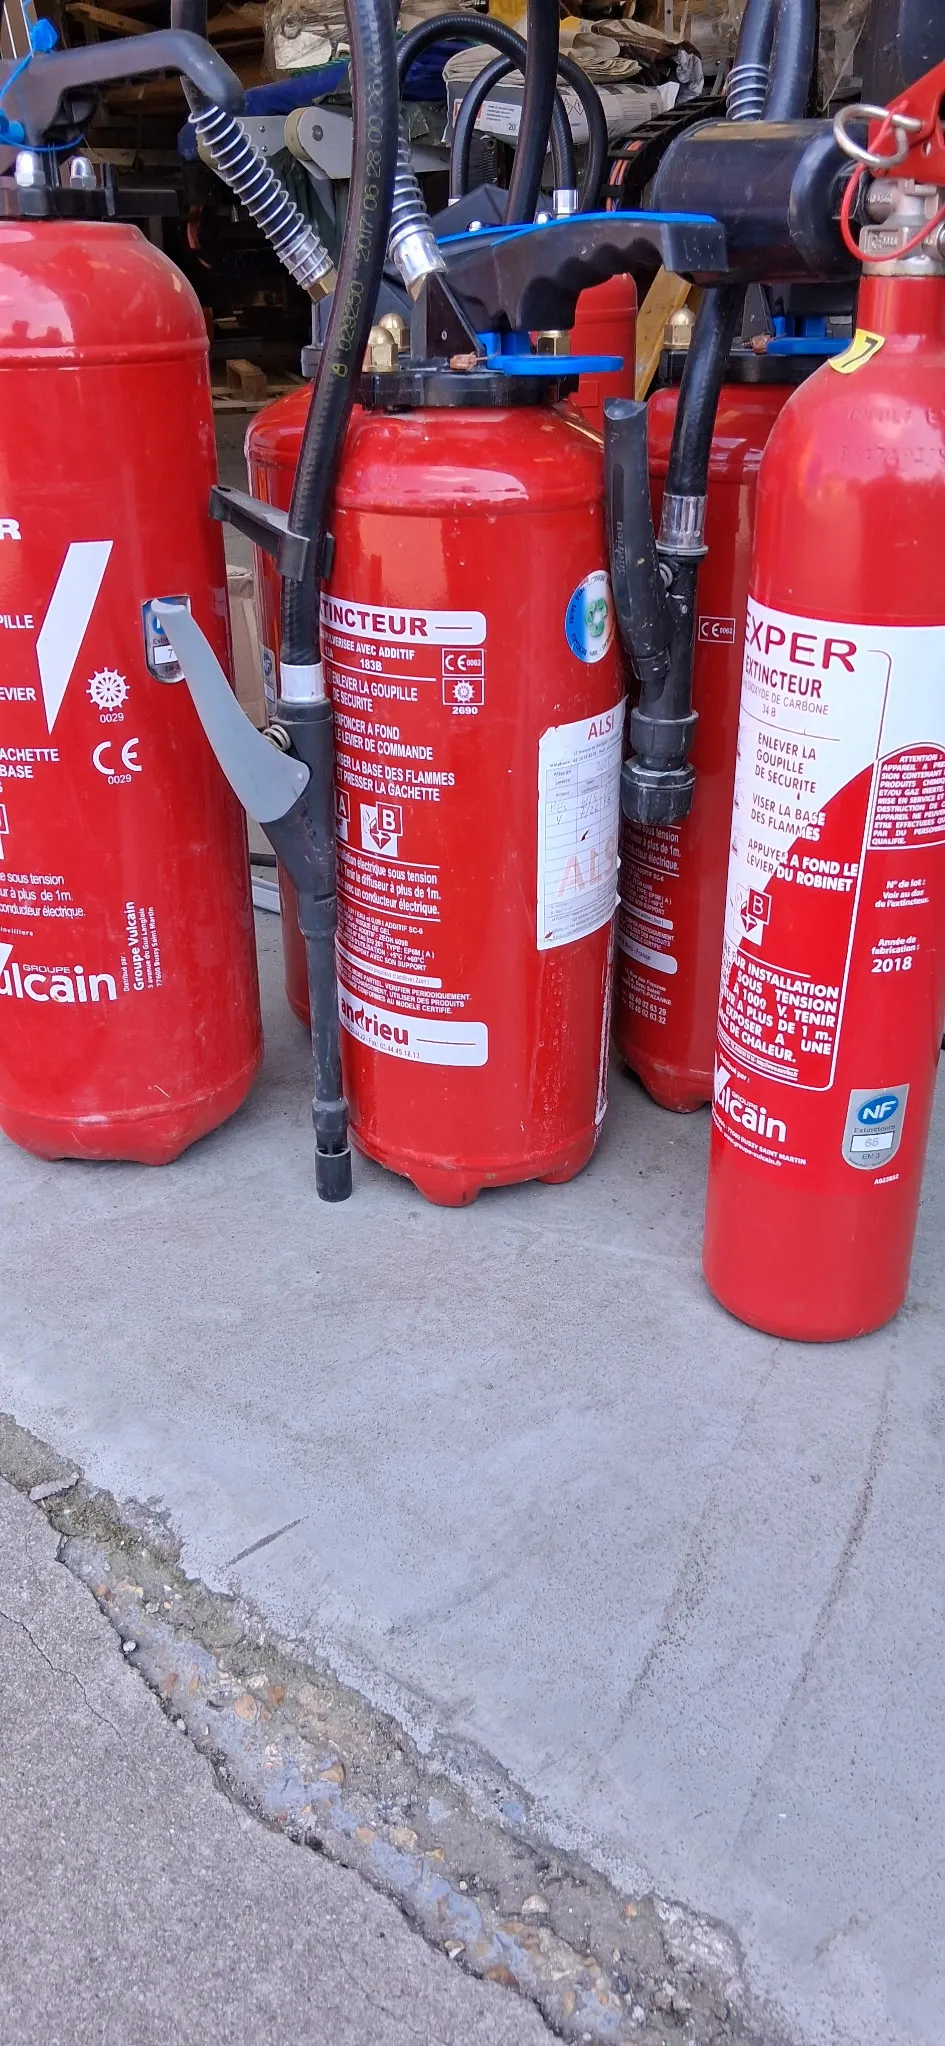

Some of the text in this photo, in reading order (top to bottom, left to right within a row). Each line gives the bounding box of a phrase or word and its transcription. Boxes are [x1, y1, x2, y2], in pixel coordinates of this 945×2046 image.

[366, 150, 382, 178] 28
[363, 184, 380, 212] 06
[355, 215, 374, 262] 2017
[338, 281, 364, 351] 029250
[320, 600, 428, 637] TINCTEUR
[356, 642, 416, 660] AVEC ADDITIF
[359, 658, 383, 672] 183B
[445, 654, 467, 671] CE
[332, 671, 418, 702] ENLEVER LA GOUPILLE
[745, 654, 822, 699] EXTINCTEUR
[340, 690, 374, 712] SECURITE
[451, 706, 479, 715] 2690
[771, 692, 781, 704] DE
[783, 696, 829, 716] CARBONE
[99, 713, 124, 724] 0029
[334, 711, 400, 740] ENFONCER A FOND
[587, 713, 615, 740] ALSI
[342, 731, 434, 760] LEVIER DE COMMANDE
[758, 732, 816, 760] ENLEVER LA
[92, 737, 143, 775] CE
[756, 749, 804, 775] GOUPILLE
[899, 754, 938, 763] ATTENTION
[0, 765, 34, 779] BASE
[107, 774, 132, 785] 0029
[351, 758, 456, 786] LA BASE DES FLAMMES
[755, 764, 817, 794] DE SECURITE
[881, 769, 942, 780] SION CONTENANT
[343, 770, 441, 802] PRESSER LA GACHETTE
[879, 788, 920, 797] ET/OU GAZ
[880, 780, 916, 788] PRODUITS
[339, 794, 347, 816] A
[752, 792, 827, 827] VISER LA BASE
[877, 802, 938, 813] DESTRUCTION DE
[878, 794, 935, 805] MISE EN SERVICE
[382, 808, 396, 831] B
[751, 808, 821, 842] DES FLAMMES
[874, 818, 935, 829] ETRE EFFECTUEES
[875, 812, 922, 821] APPAREIL NE
[656, 828, 679, 843] tension
[873, 829, 907, 837] PAR DU
[660, 842, 669, 854] de
[748, 838, 859, 877] APPUYER A FOND LE
[7, 872, 29, 884] sous
[30, 873, 64, 885] tension
[387, 864, 406, 880] sous
[407, 870, 438, 884] tension
[746, 852, 854, 892] LEVIER DU ROBINET
[361, 874, 424, 899] diffuseur plus de
[898, 879, 922, 888] de lot
[18, 889, 53, 902] plus de
[361, 889, 440, 915] conducteur électrique.
[874, 900, 886, 908] de
[882, 891, 899, 899] Voir
[911, 889, 924, 897] dos
[42, 905, 86, 919] électrique.
[752, 896, 764, 915] B
[138, 907, 148, 936] Langlois
[148, 906, 156, 929] Martin
[124, 901, 145, 991] Groupe Vulcain
[871, 944, 916, 955] fabrication
[878, 936, 917, 947] Année de
[23, 964, 71, 974] GROUPE
[397, 960, 427, 971] SUPPORT
[871, 956, 912, 973] 2018
[385, 983, 411, 995] VERIFIER
[747, 962, 839, 999] INSTALLATION
[389, 992, 465, 1008] UTILISER DES PRODUITS
[737, 969, 837, 1013] SOUS TENSION
[396, 1000, 421, 1011] MODELE
[733, 983, 739, 996] A
[743, 989, 767, 1010] 1000
[776, 1003, 788, 1018] V.
[794, 1008, 836, 1028] TENIR
[341, 997, 409, 1046] andrieu
[725, 1003, 763, 1037] EXPOSER
[774, 1033, 785, 1046] A
[800, 1039, 832, 1056] UNE
[737, 1000, 833, 1042] A PLUS DE 1 m.
[729, 1023, 740, 1039] DE
[741, 1030, 797, 1063] CHALEUR.
[731, 1090, 759, 1111] GROUPE
[862, 1100, 897, 1120] NF
[853, 1124, 896, 1133] Extincteurs
[759, 1146, 778, 1158] SAINT
[778, 1152, 807, 1166] MARTIN
